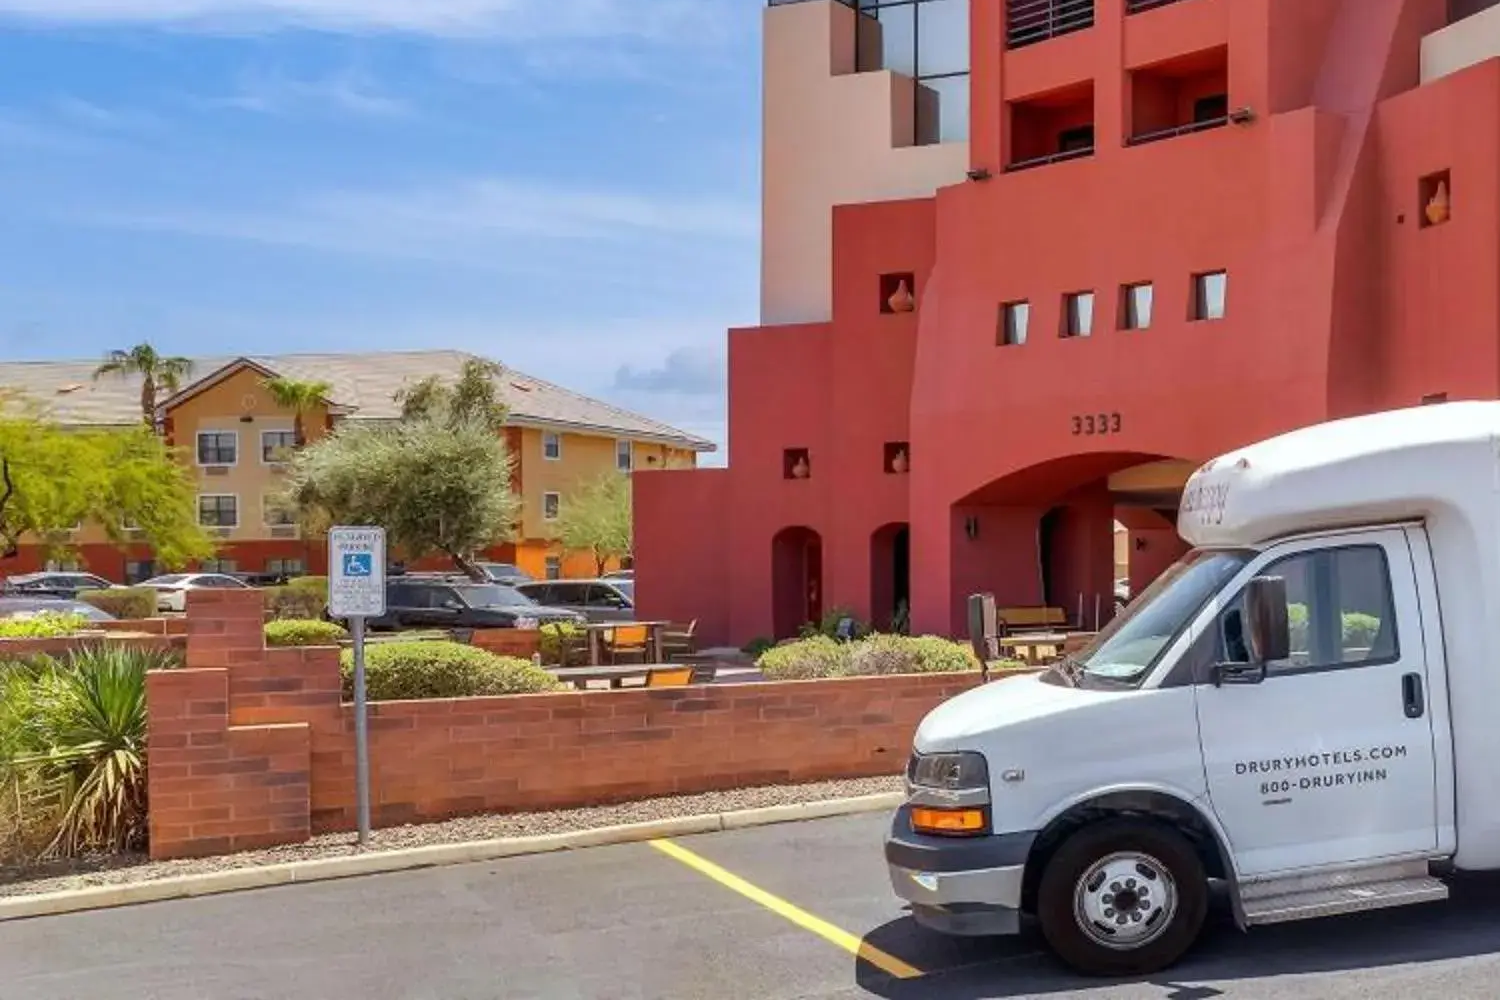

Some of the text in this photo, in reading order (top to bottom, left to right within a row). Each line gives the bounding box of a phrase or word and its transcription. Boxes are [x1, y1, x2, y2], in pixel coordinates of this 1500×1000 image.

[1071, 412, 1122, 436] 3333
[1234, 744, 1408, 776] DRURYHOTELS.COM
[1259, 768, 1388, 795] 800-DRURYINN
